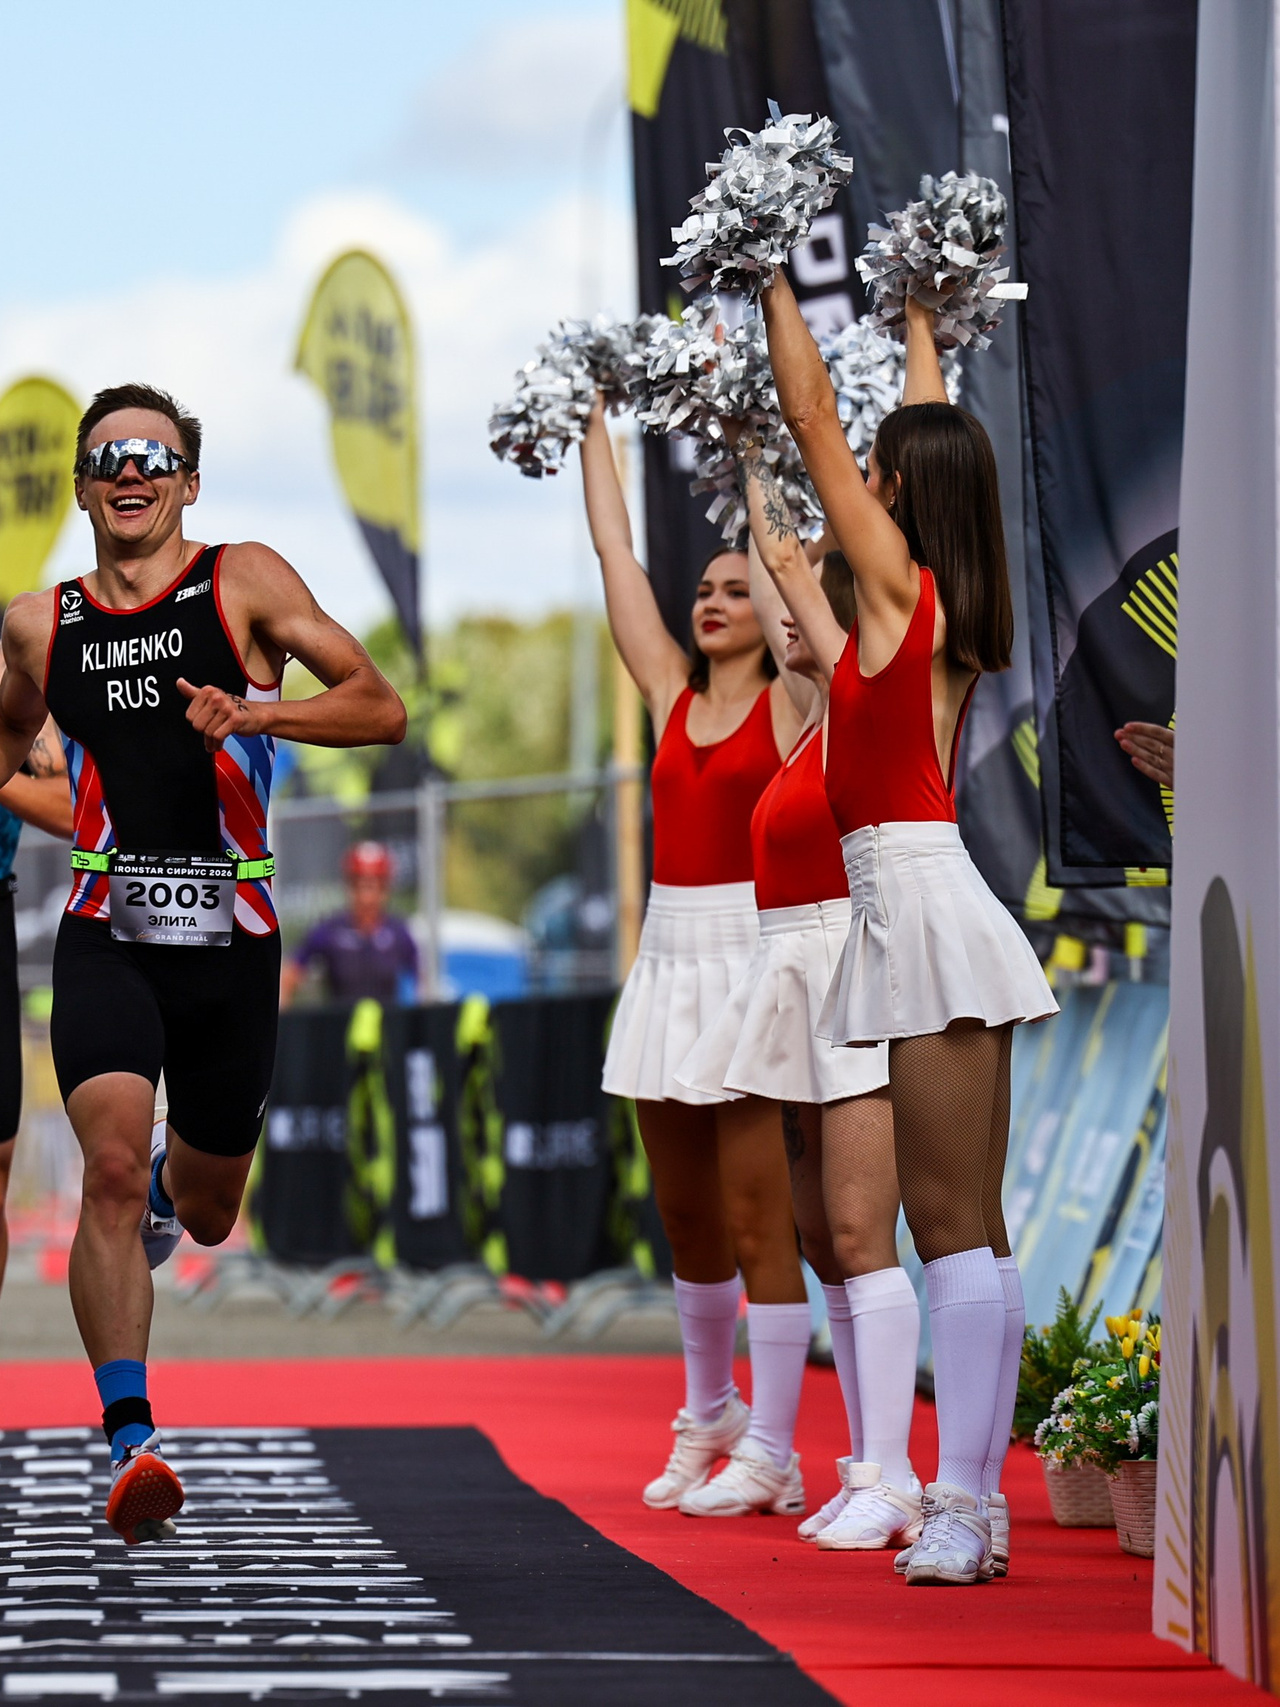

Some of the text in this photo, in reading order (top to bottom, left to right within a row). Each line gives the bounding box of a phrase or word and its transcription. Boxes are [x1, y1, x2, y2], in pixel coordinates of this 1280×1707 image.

[81, 628, 183, 673] KLIMENKO
[106, 675, 160, 712] RUS
[114, 865, 233, 877] IRONSTAR СИРИУС 2026
[125, 881, 220, 910] 2003
[148, 915, 198, 928] ЭЛИТА
